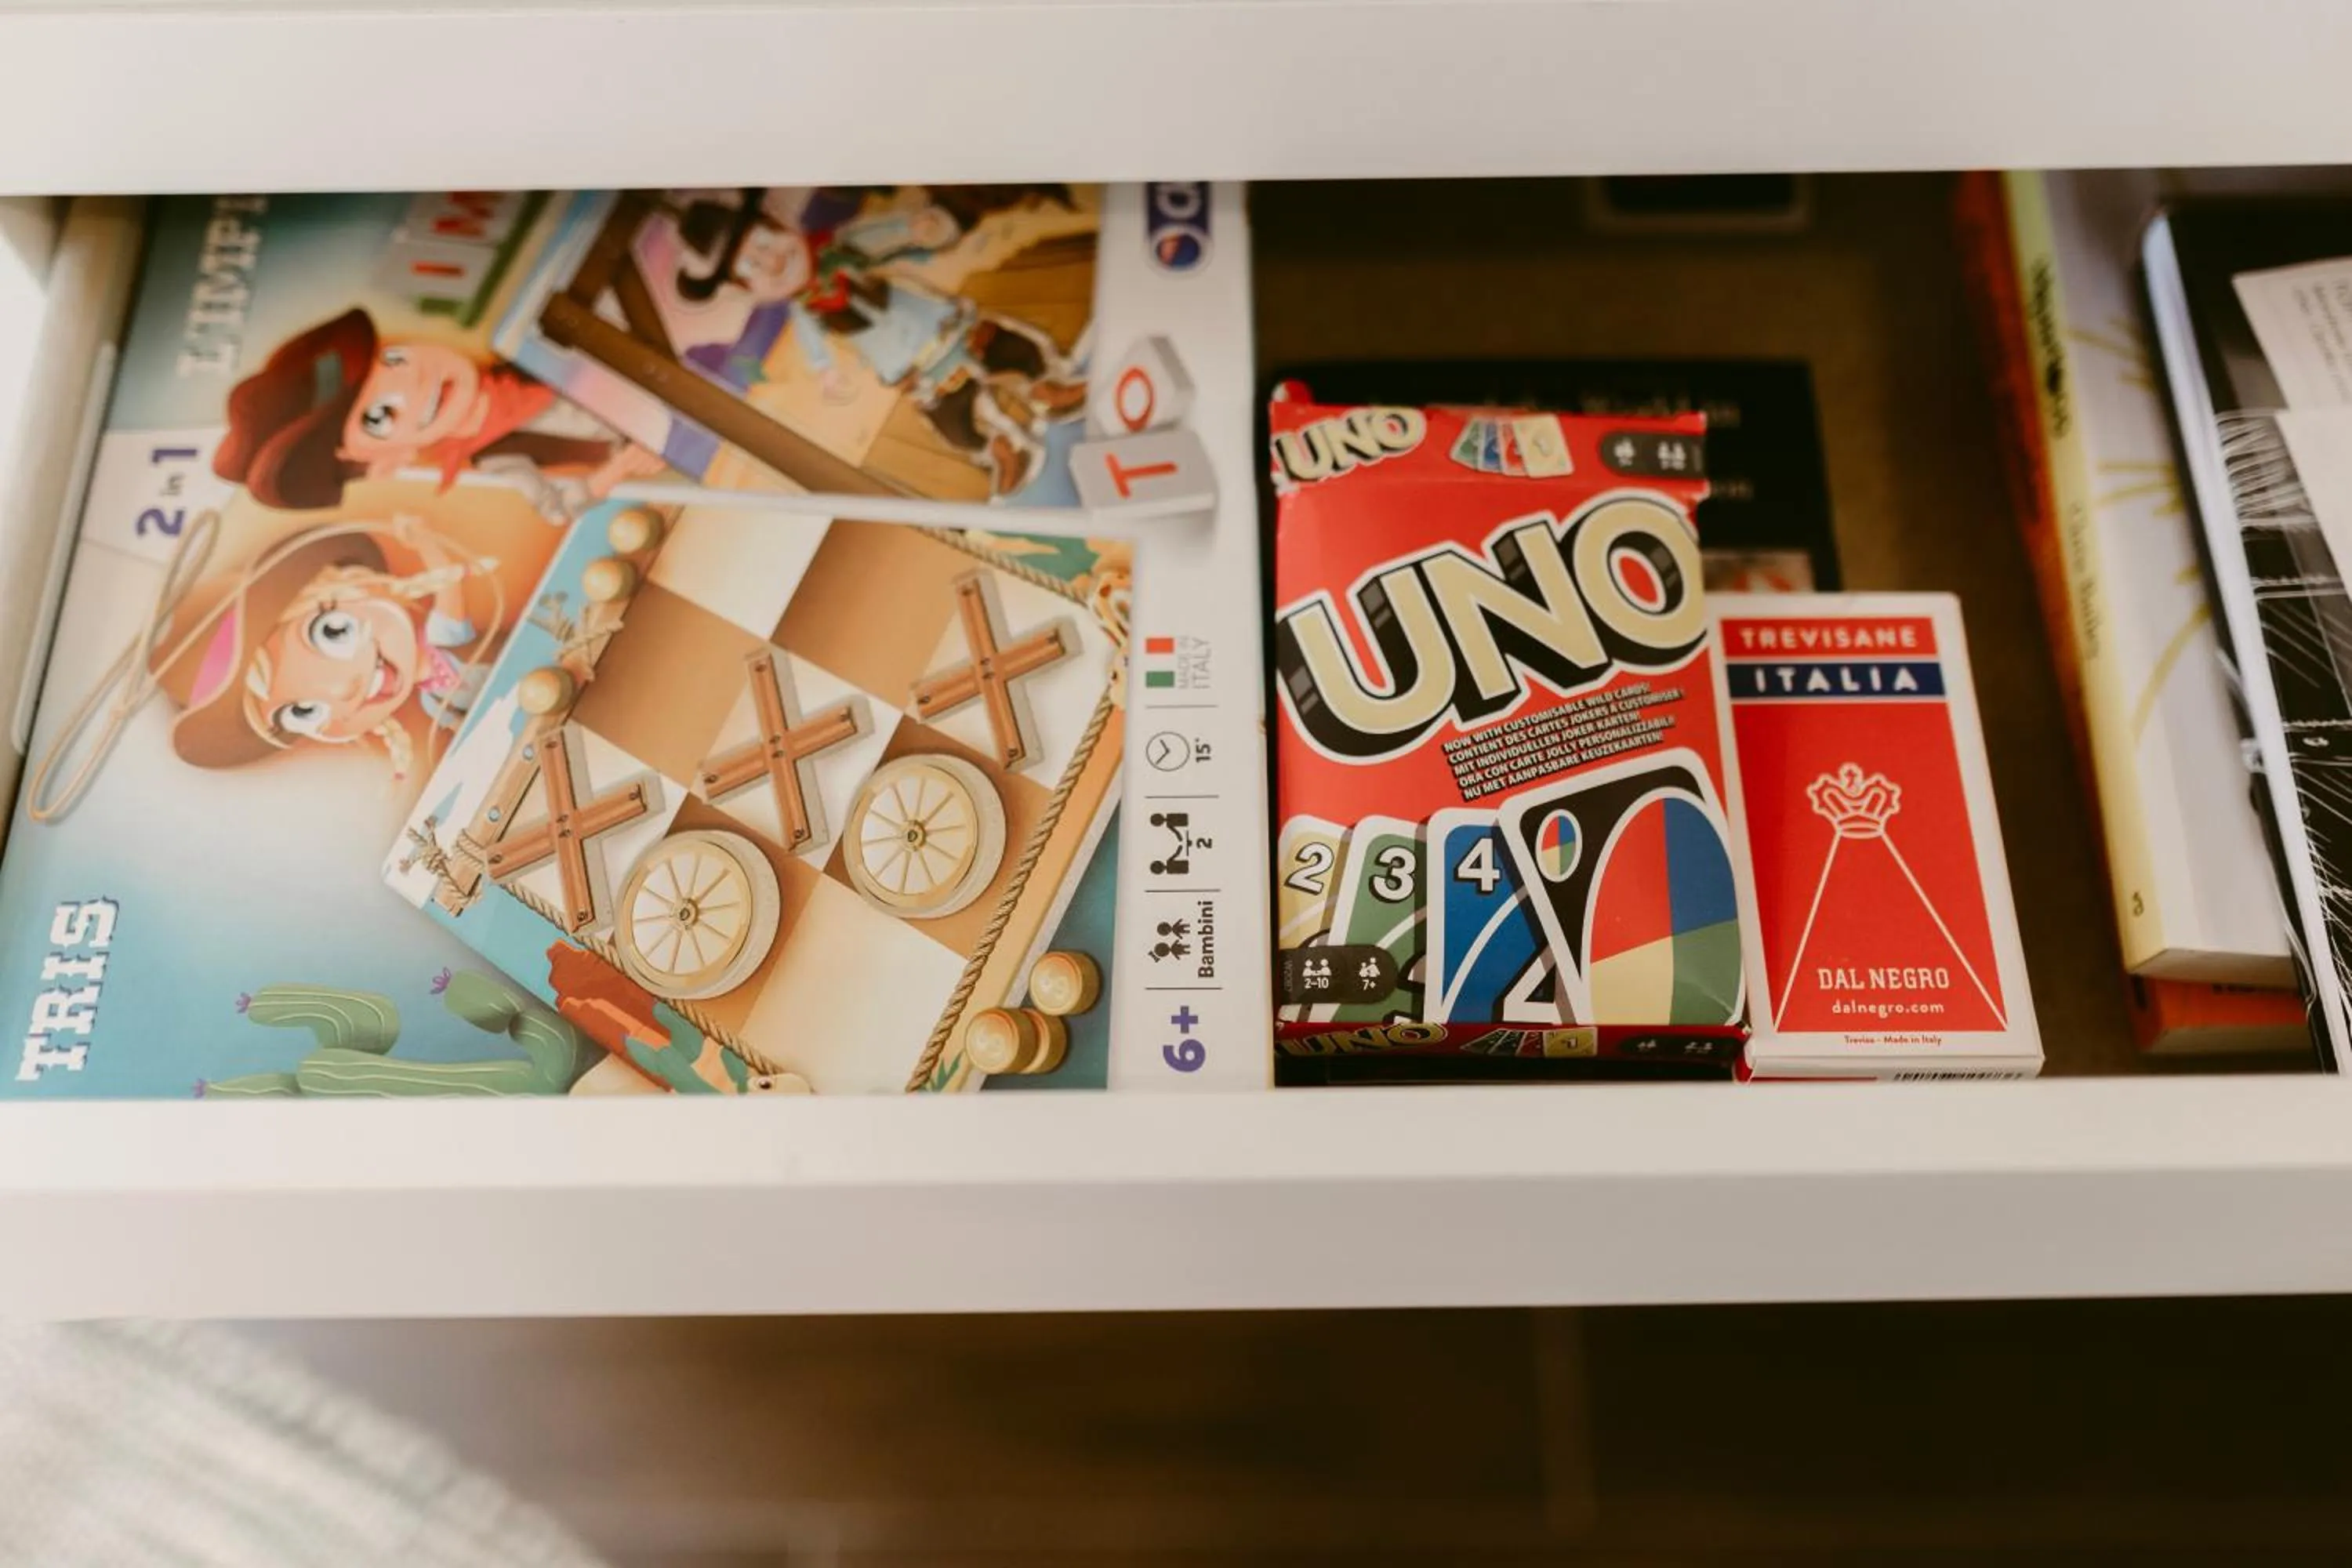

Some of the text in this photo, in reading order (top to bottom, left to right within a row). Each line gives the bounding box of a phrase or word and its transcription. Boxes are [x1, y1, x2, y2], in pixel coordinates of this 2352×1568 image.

[151, 448, 198, 464] 1
[1275, 406, 1427, 481] UNO
[135, 508, 185, 538] 2
[1276, 490, 1708, 760] UNO
[1738, 625, 1918, 650] TREVISANE
[1192, 637, 1210, 690] ITALY
[1755, 666, 1918, 693] ITALIA
[1443, 734, 1472, 752] NOW
[1472, 727, 1503, 743] WITH
[1504, 699, 1585, 733] CUSTOMISABLE
[1585, 691, 1613, 706] WILD
[1449, 737, 1503, 764] CONTIENT
[1504, 731, 1527, 746] DES
[1527, 716, 1569, 738] CARTES
[1570, 705, 1610, 724] JOKERS
[1454, 761, 1475, 776] MIT
[1476, 732, 1561, 768] INDIVIDUELLEN
[1560, 722, 1595, 742] JOKER
[1458, 771, 1484, 787] ORA
[1484, 764, 1509, 779] CON
[1509, 750, 1545, 770] CARTE
[1546, 739, 1578, 760] JOLLY
[1464, 786, 1481, 800] NU
[1482, 778, 1507, 793] MET
[1508, 753, 1581, 785] AANPASBARE
[1196, 837, 1213, 850] 2
[1454, 837, 1500, 895] 4
[1287, 843, 1334, 895] 2
[1369, 844, 1416, 902] 3
[1197, 900, 1215, 978] Bambini
[15, 895, 119, 1081] TRIS
[1362, 979, 1376, 991] 7+
[1817, 967, 1951, 990] DAL NEGRO
[1831, 999, 1944, 1019] dalnegro.com
[1163, 1005, 1207, 1073] 6+
[1276, 1019, 1447, 1056] UNO
[1884, 1034, 1908, 1044] Made
[1911, 1036, 1920, 1044] in
[1922, 1033, 1941, 1047] Italy
